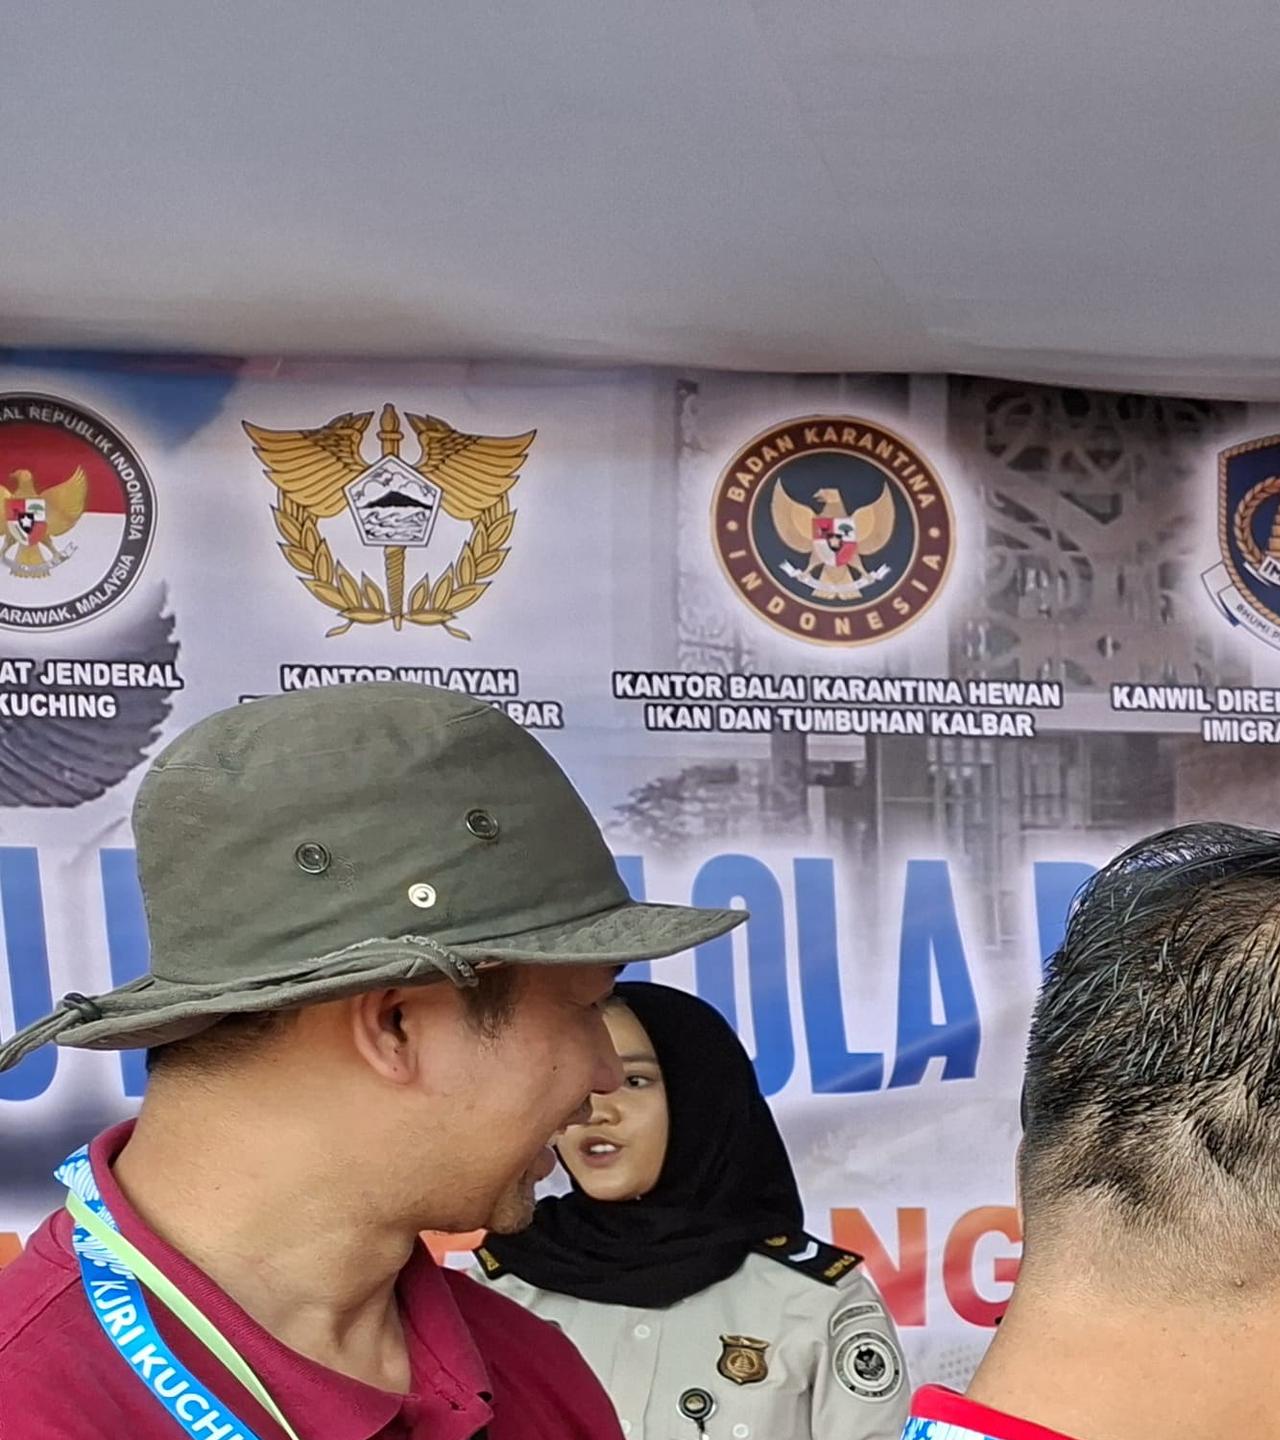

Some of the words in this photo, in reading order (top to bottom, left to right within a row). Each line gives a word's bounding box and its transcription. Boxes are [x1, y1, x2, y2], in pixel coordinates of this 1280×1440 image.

[30, 405, 112, 454] REPUBLIK
[728, 434, 795, 503] BADAN
[77, 553, 135, 614] MALAYSIA
[40, 661, 183, 689] JENDERAL
[614, 673, 723, 699] KANTOR
[730, 676, 806, 700] BALAI
[812, 678, 960, 705] KARANTINA
[968, 682, 1061, 706] HEWAN
[1112, 686, 1210, 712] KANWIL
[647, 705, 711, 730] IKAN
[719, 707, 775, 731] DAN
[779, 708, 925, 735] TUMBUHAN
[931, 713, 1036, 738] KALBAR
[90, 1279, 145, 1350] KJRI
